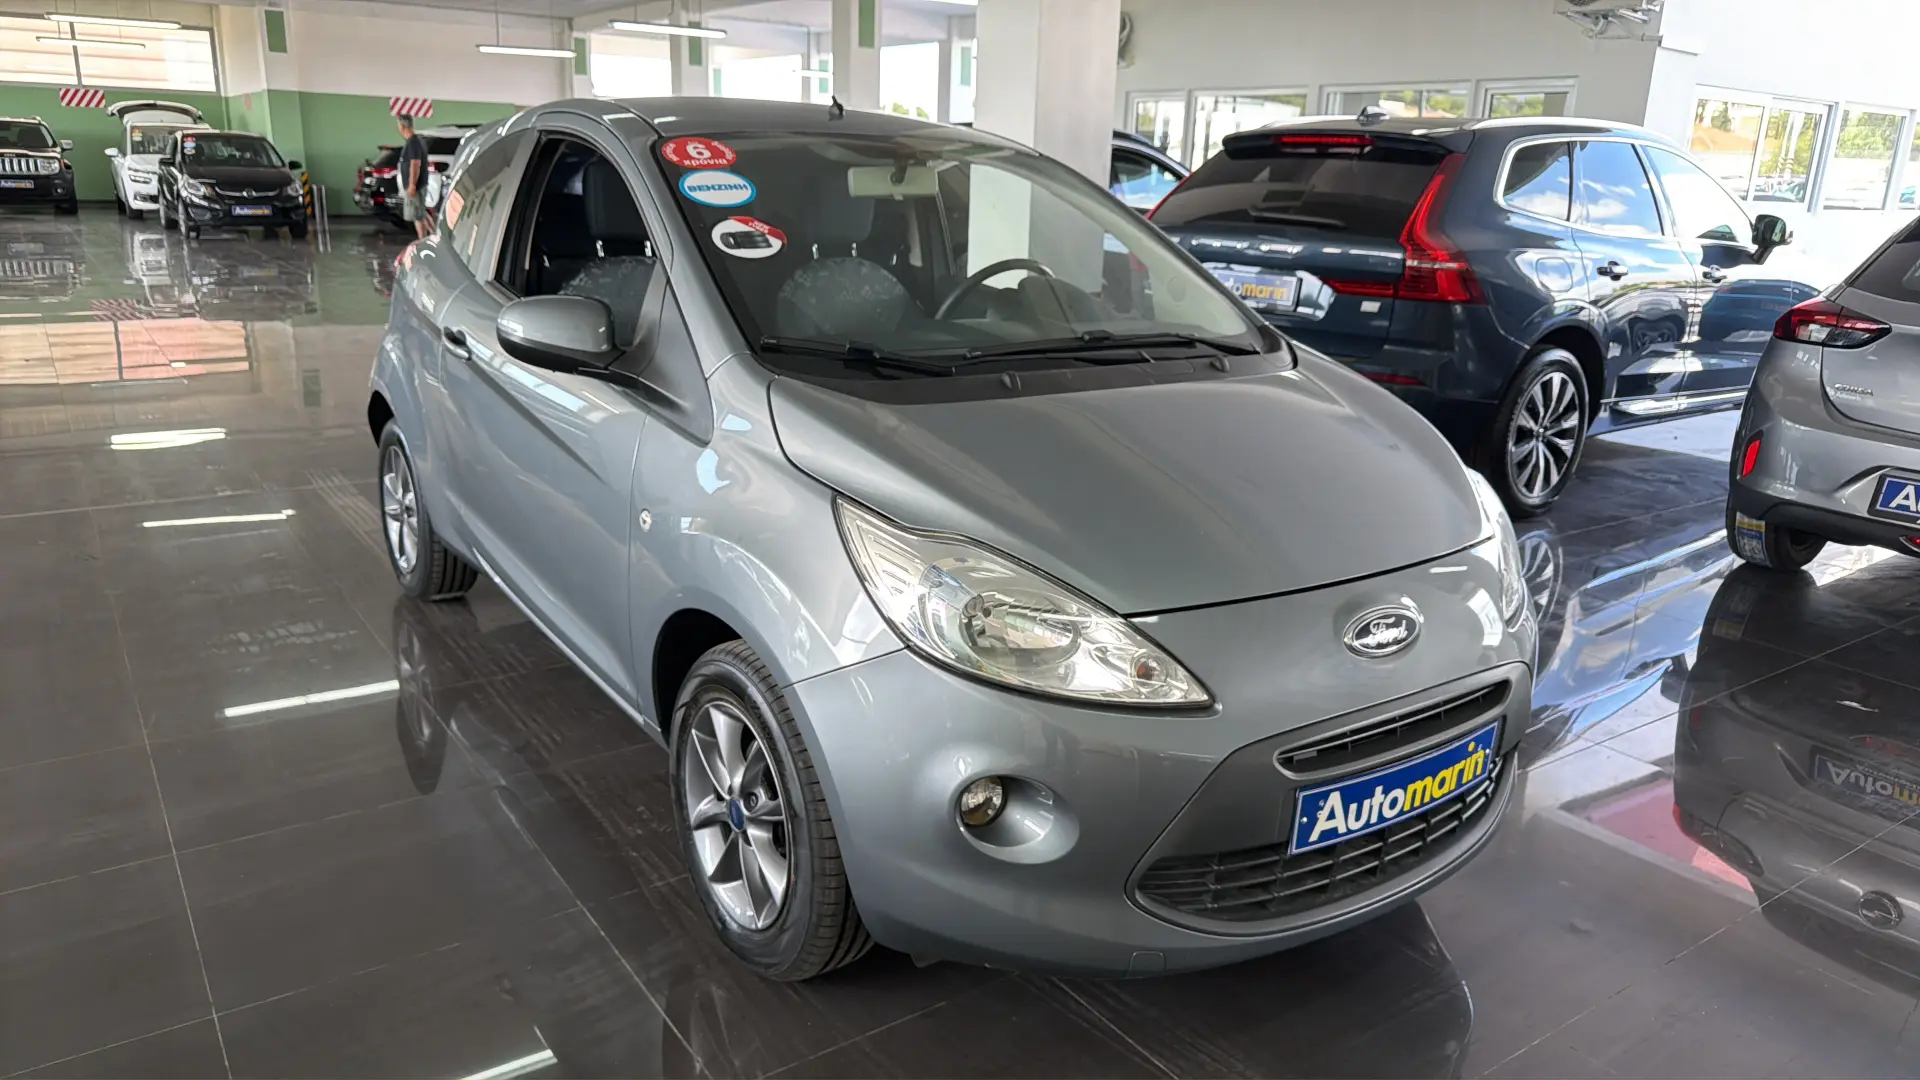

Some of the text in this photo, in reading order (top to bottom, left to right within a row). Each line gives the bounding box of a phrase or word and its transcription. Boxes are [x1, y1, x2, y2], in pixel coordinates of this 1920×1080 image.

[686, 143, 712, 159] 6
[687, 183, 749, 192] ΒΕΝΖΙΝΗ
[1356, 616, 1408, 647] Ford
[1308, 741, 1485, 843] Automarin
